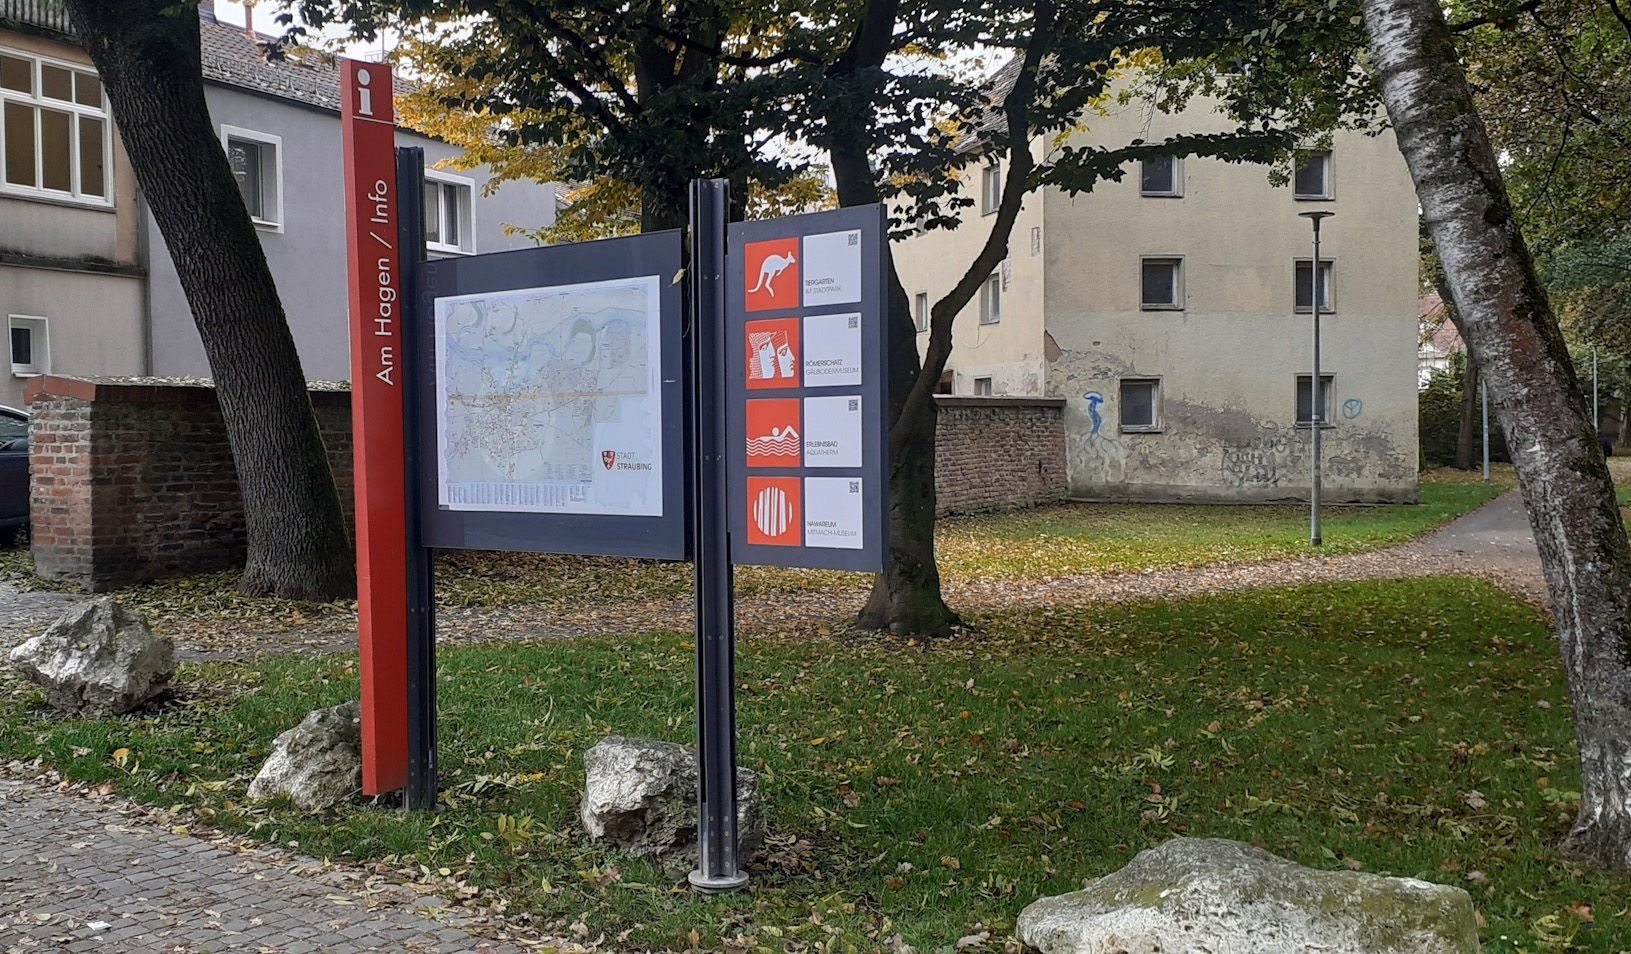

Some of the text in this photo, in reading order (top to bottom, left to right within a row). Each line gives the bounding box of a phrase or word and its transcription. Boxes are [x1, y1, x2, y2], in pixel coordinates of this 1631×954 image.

[368, 179, 396, 386] Am Hagen / Info
[805, 277, 834, 287] TIERGARTEN
[805, 359, 843, 367] RÖMERSCHATZ
[806, 440, 839, 448] ERLEBNISBAD
[616, 451, 635, 460] STADT
[616, 462, 652, 471] STRAUBING
[807, 520, 837, 528] NAWAREUM
